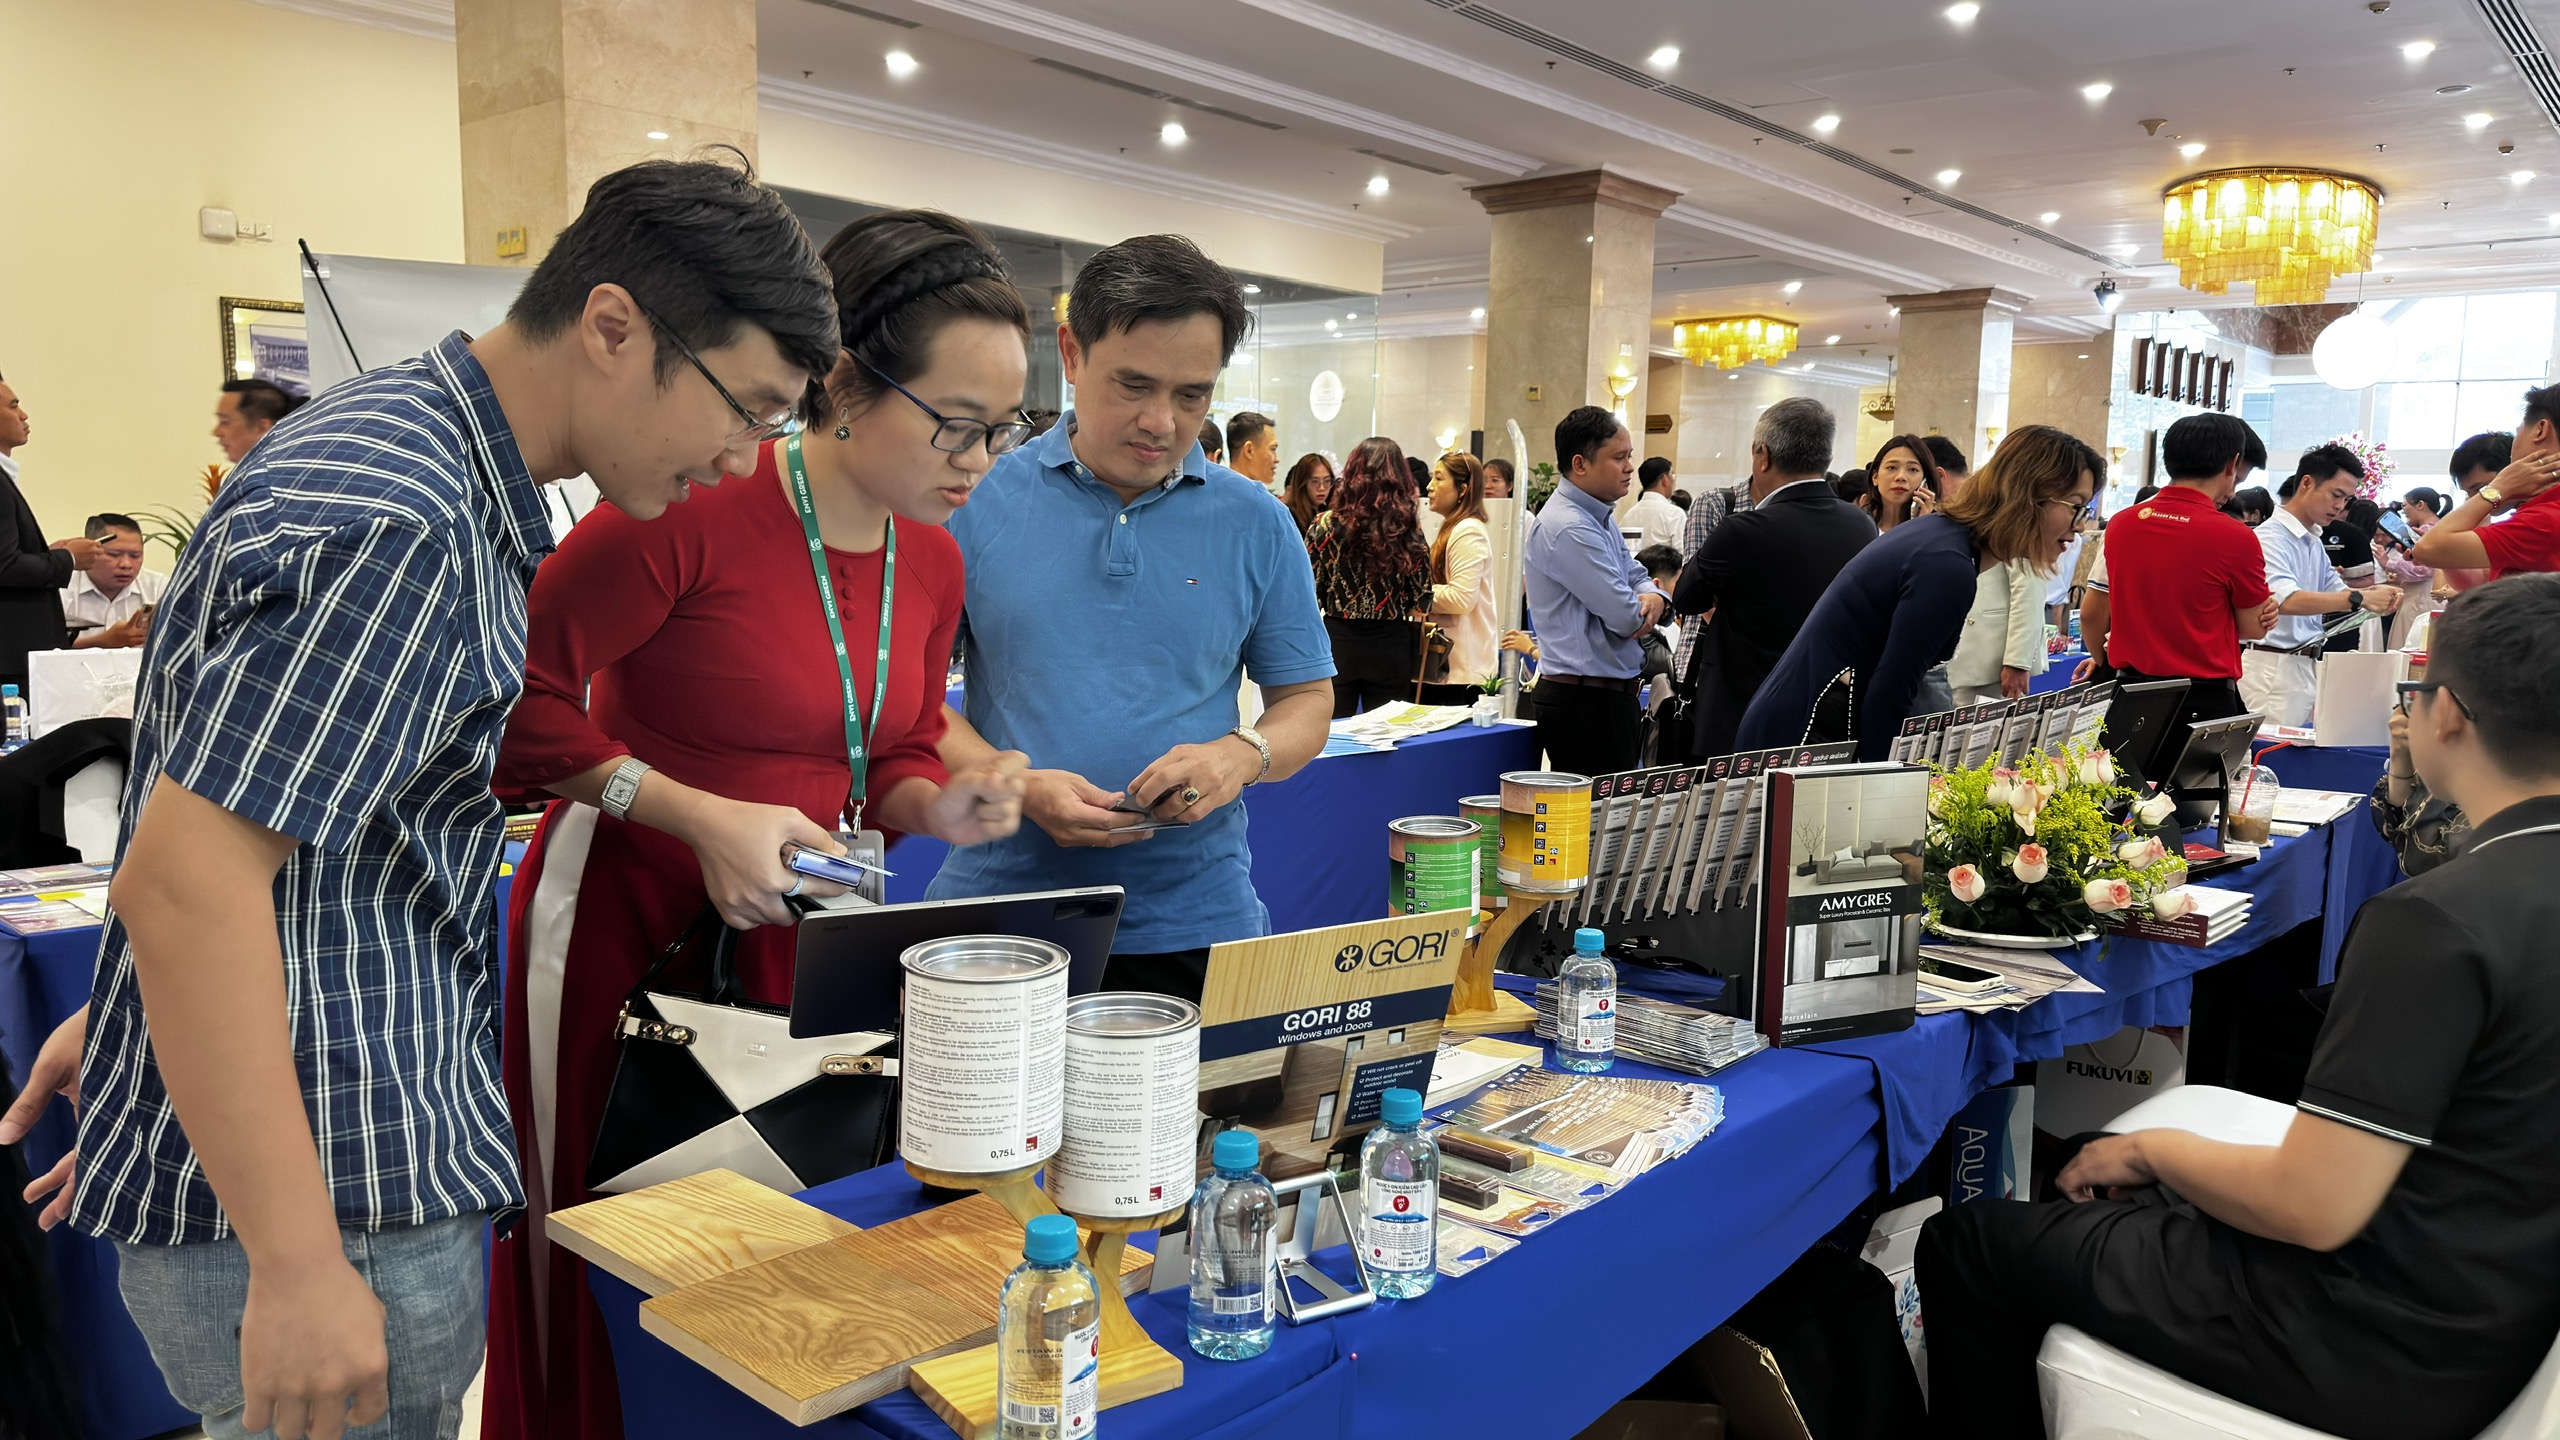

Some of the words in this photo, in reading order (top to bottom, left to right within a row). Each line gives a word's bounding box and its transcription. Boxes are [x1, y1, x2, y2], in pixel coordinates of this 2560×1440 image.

[795, 470, 807, 495] GREEN
[801, 495, 811, 514] ENVI
[821, 575, 831, 599] GREEN
[826, 599, 836, 619] ENVI
[846, 679, 854, 704] GREEN
[1819, 892, 1892, 911] AMYGRES
[1368, 929, 1450, 968] GORI
[1283, 1005, 1341, 1031] GORI
[1346, 1000, 1372, 1019] 88
[1784, 1013, 1818, 1021] Porcelain
[1278, 1030, 1322, 1044] Windows
[1324, 1026, 1342, 1036] and
[1344, 1020, 1373, 1034] Doors
[2066, 1060, 2132, 1083] FUKUVI
[1957, 1126, 1989, 1203] AQUA
[1115, 1197, 1133, 1205] 0,75
